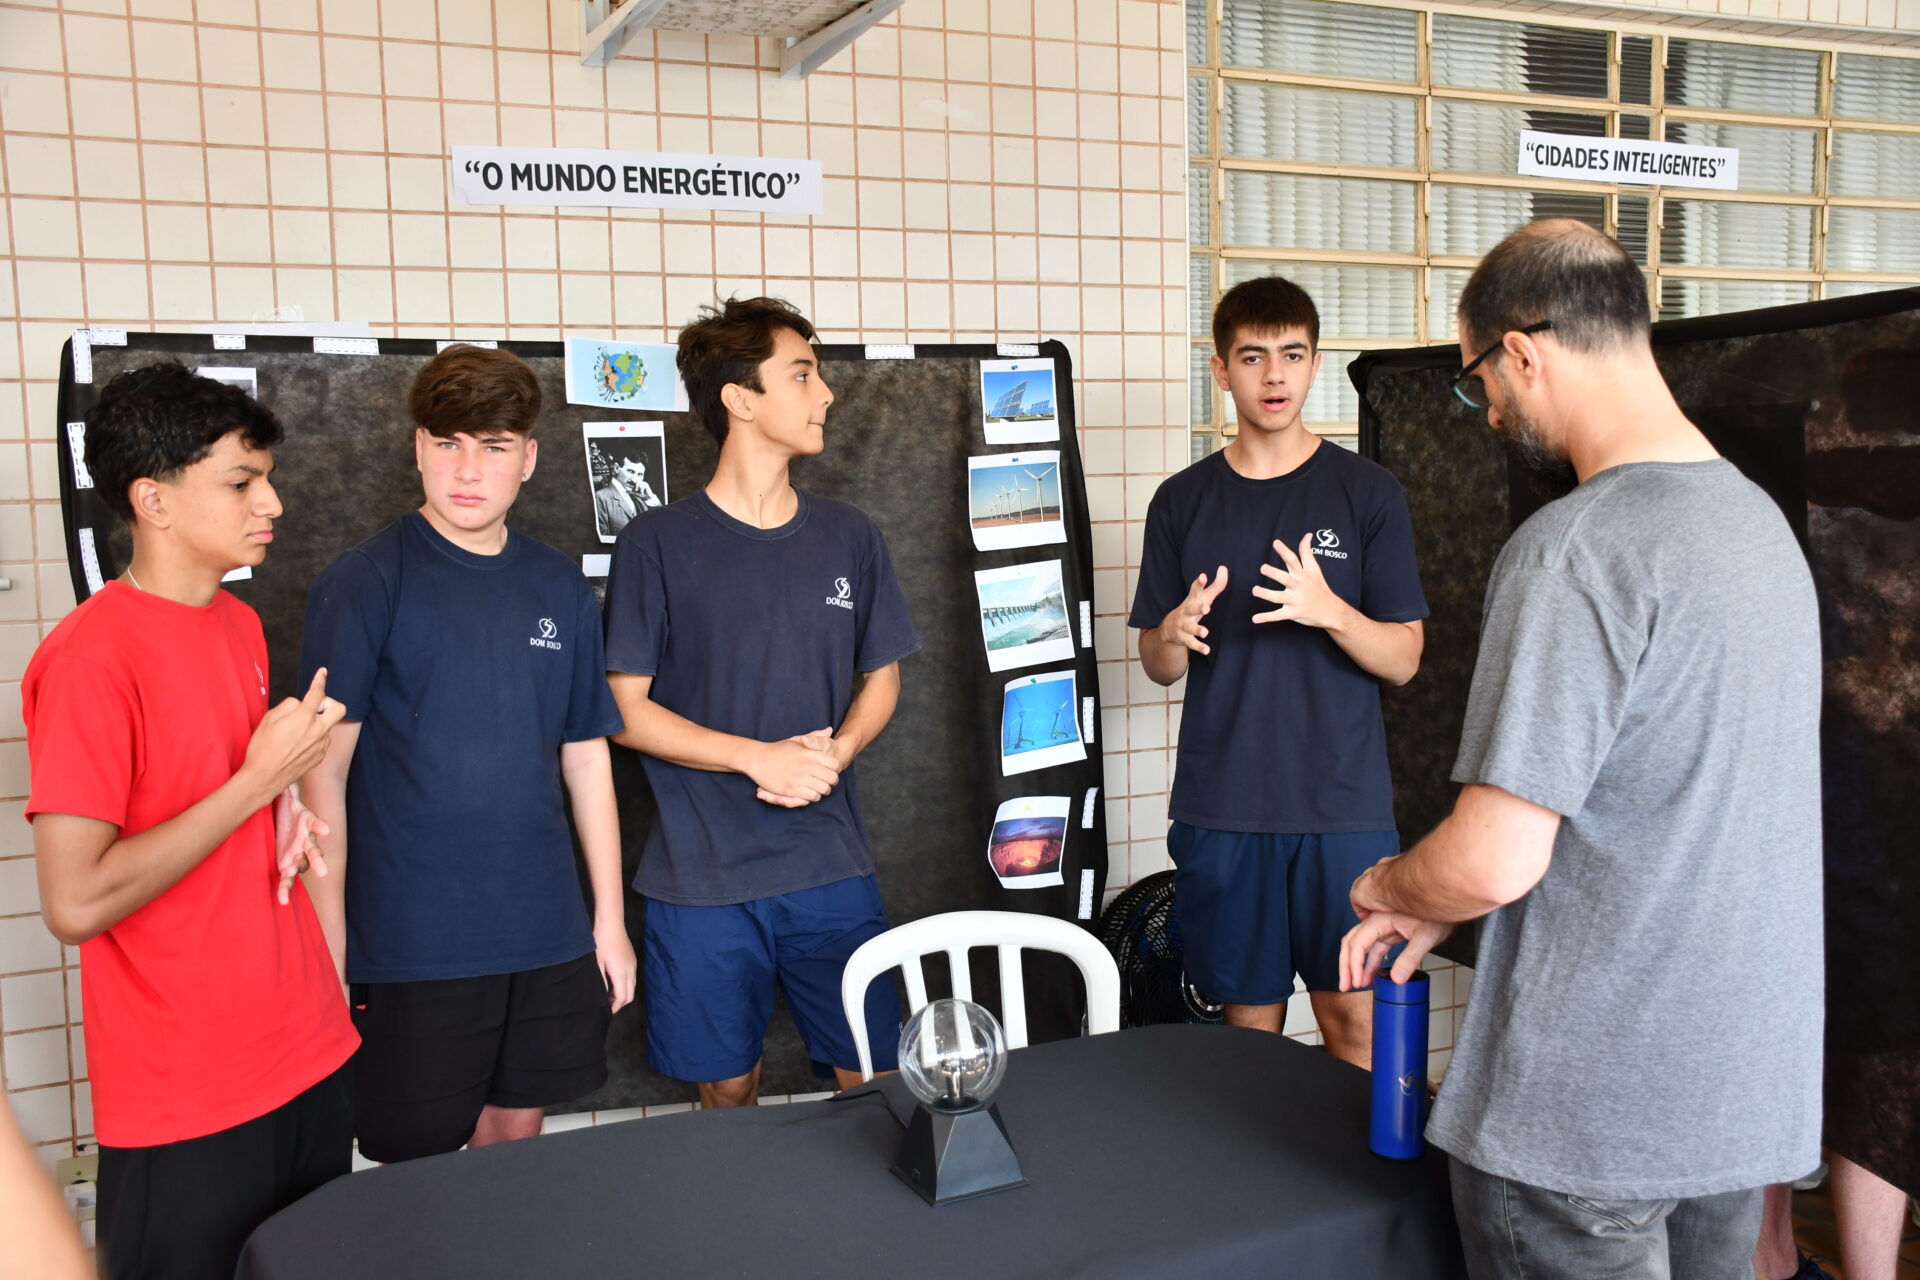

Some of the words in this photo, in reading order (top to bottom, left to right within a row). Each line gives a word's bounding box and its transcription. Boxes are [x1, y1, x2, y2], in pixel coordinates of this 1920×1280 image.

[1526, 142, 1609, 171] “CIDADES
[1613, 150, 1725, 178] INTELIGENTES”
[465, 160, 503, 191] “O
[510, 163, 616, 192] MUNDO
[623, 163, 800, 199] ENERGÉTICO”
[1311, 547, 1323, 555] OM
[1324, 549, 1348, 559] BOSCO
[530, 637, 545, 647] DOM
